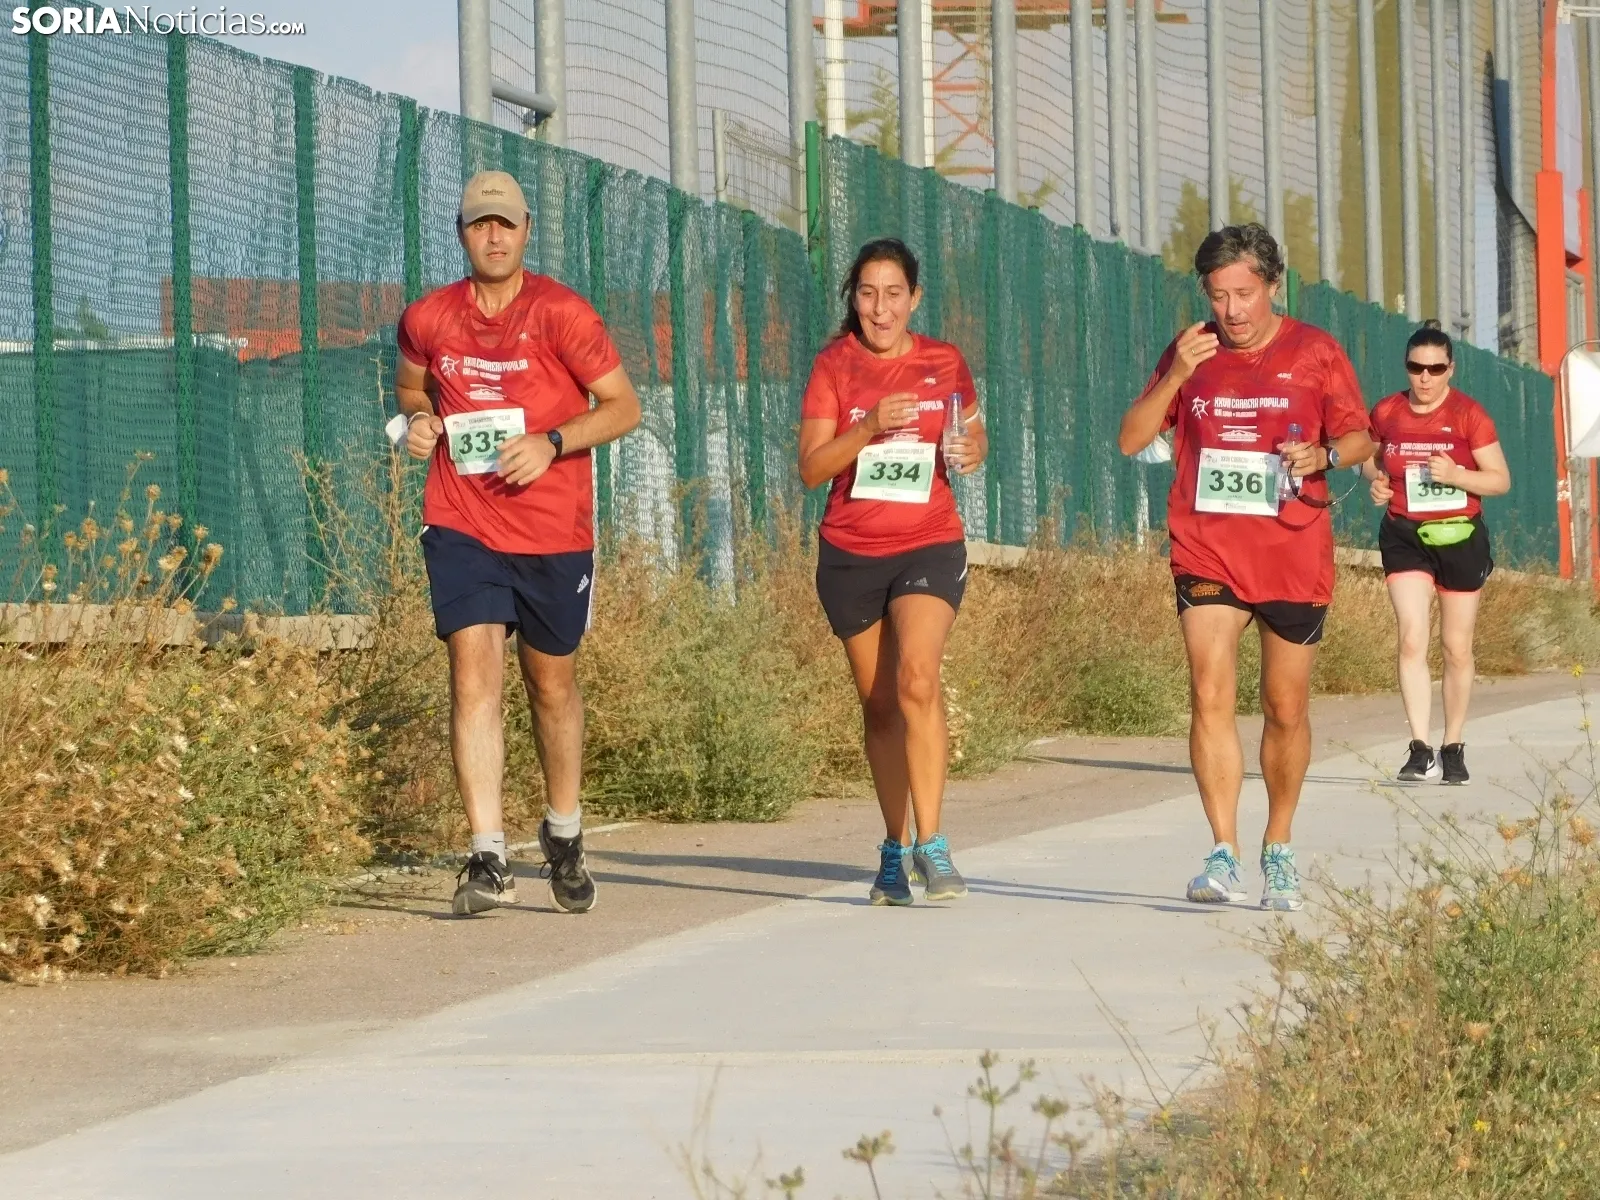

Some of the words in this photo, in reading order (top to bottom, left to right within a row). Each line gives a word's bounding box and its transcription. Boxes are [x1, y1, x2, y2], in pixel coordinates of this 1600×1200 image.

[502, 358, 528, 371] POPULAR
[919, 400, 944, 411] POPULAR
[1231, 398, 1259, 409] CARRERA
[1259, 396, 1289, 409] POPULAR
[869, 461, 921, 483] 334
[1208, 469, 1264, 495] 336
